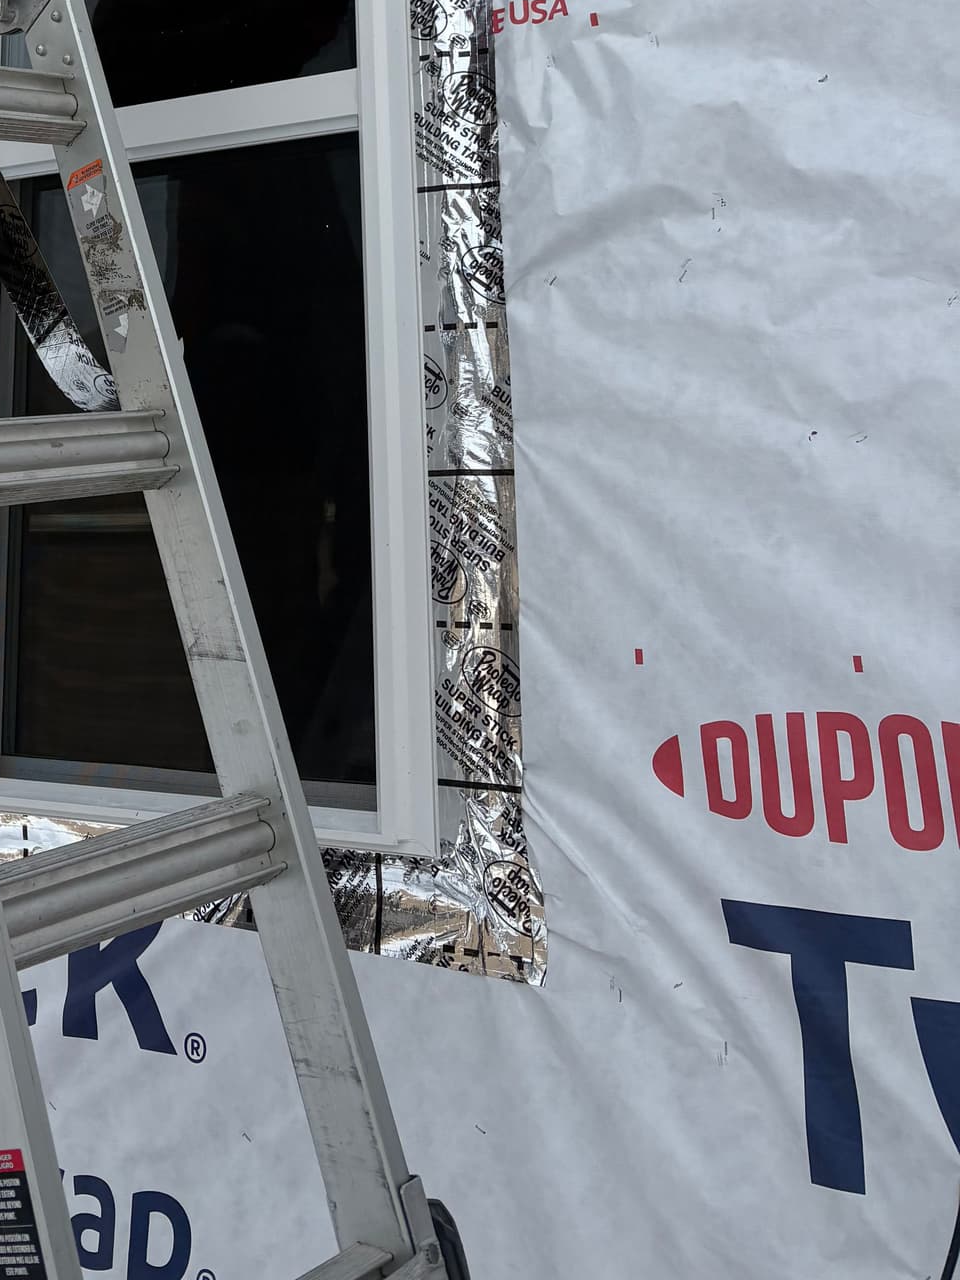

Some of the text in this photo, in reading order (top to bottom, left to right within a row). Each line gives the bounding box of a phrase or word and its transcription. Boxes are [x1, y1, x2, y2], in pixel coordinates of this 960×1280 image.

[424, 102, 494, 154] SUPER STICK
[460, 146, 491, 171] TAPE
[429, 493, 505, 562] BUILDING TAP
[430, 516, 490, 572] SUPER STIC
[442, 678, 518, 752] SUPER STICK
[482, 738, 513, 771] TAPE
[700, 711, 960, 853] DUPO
